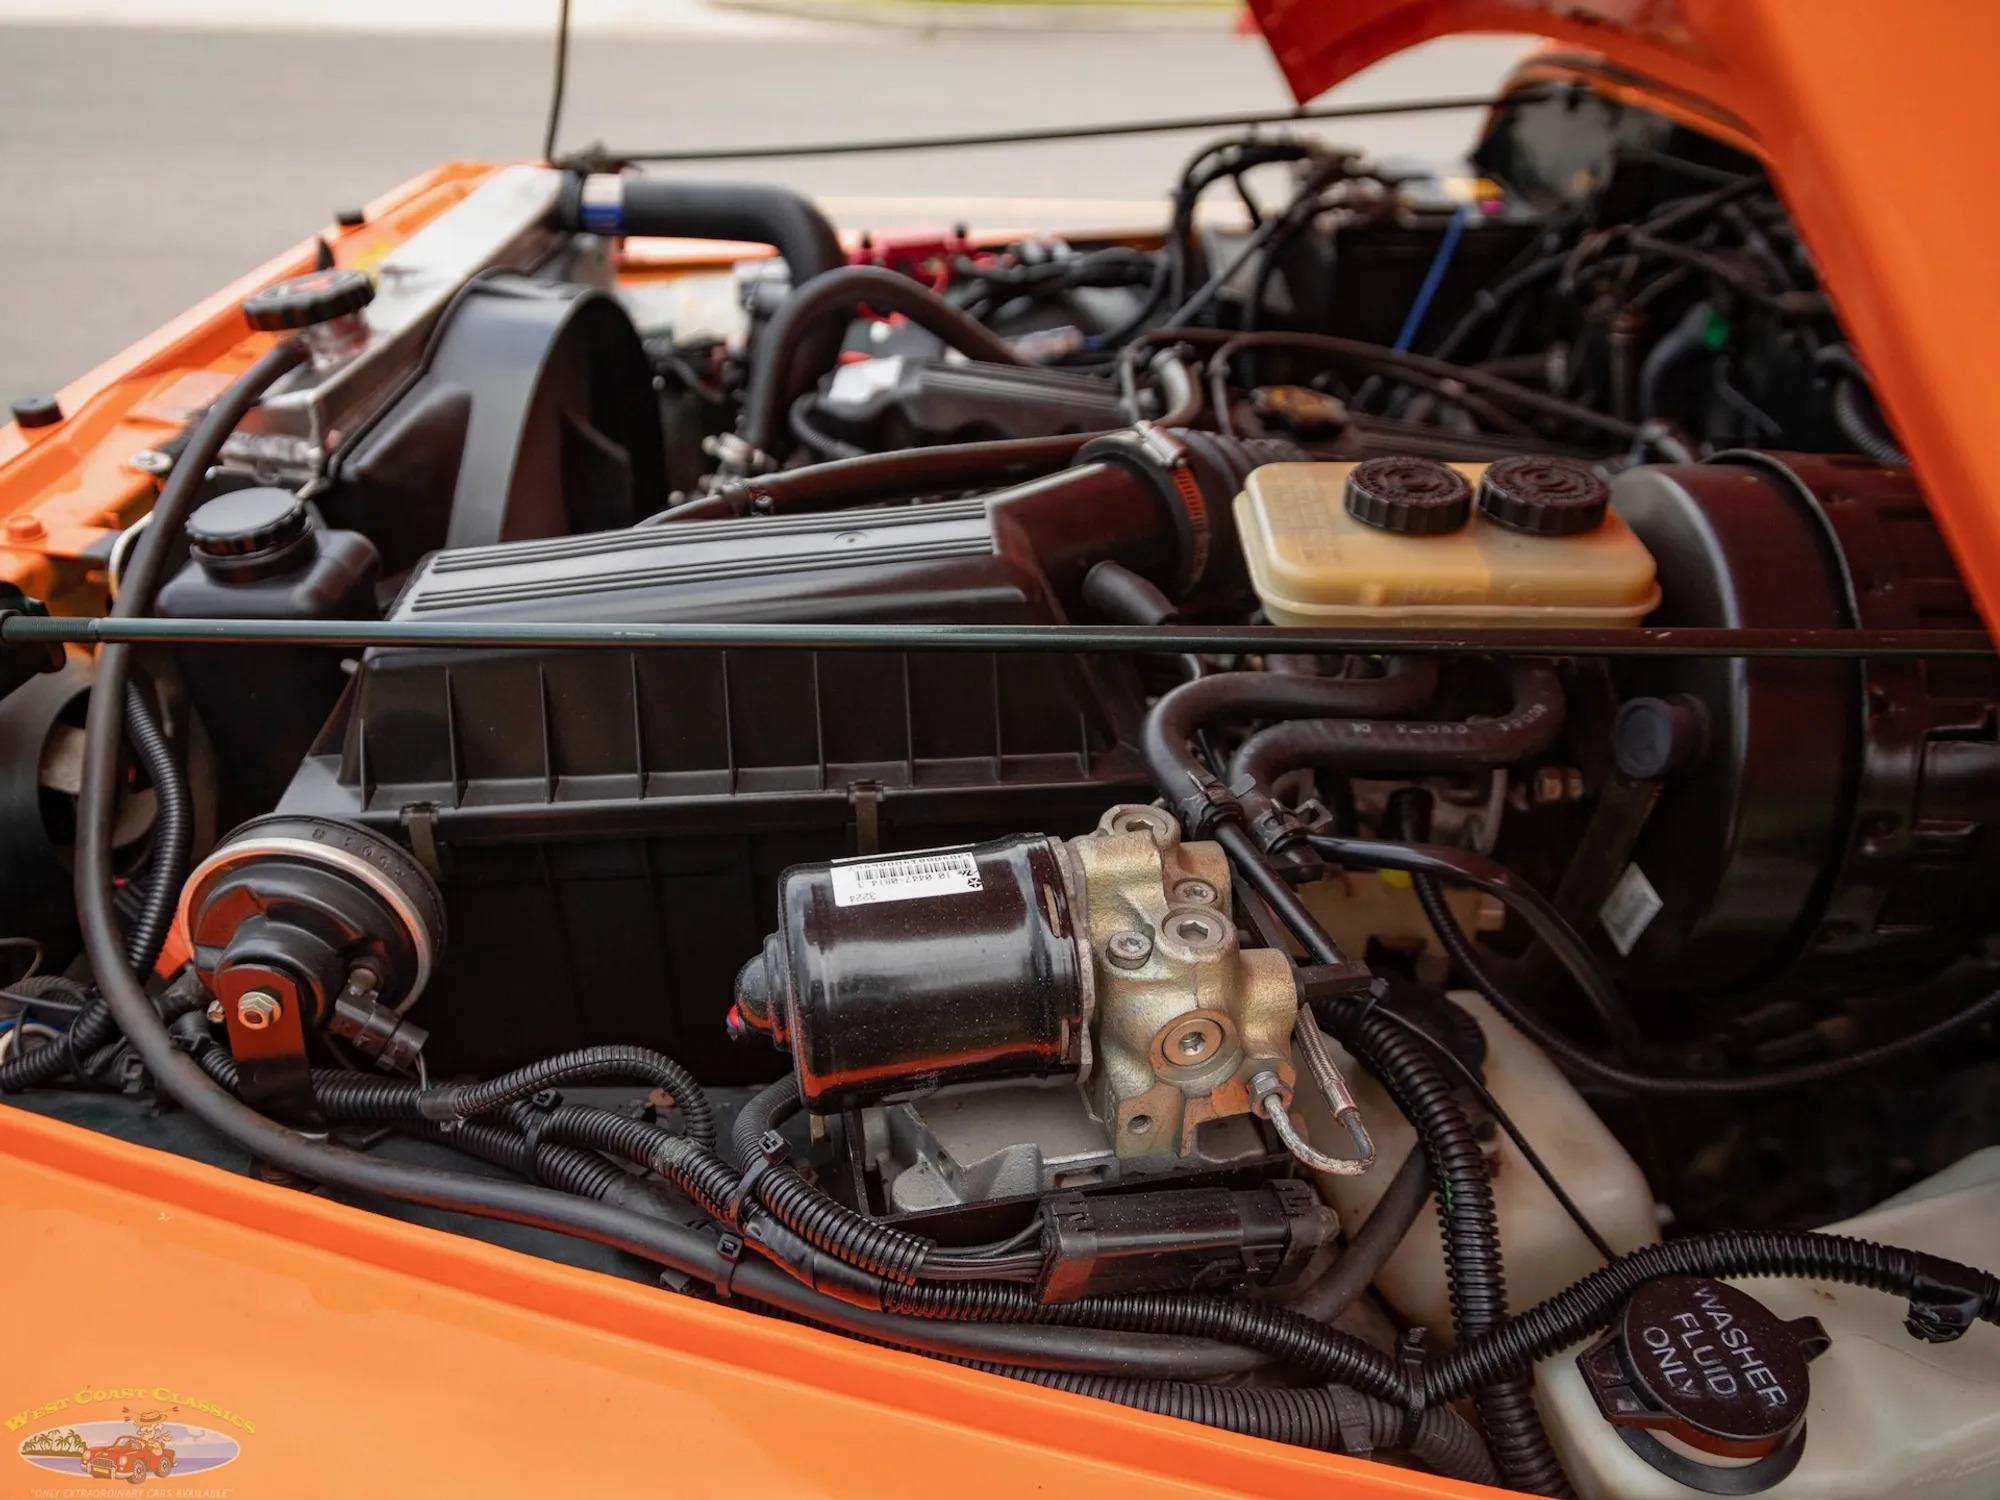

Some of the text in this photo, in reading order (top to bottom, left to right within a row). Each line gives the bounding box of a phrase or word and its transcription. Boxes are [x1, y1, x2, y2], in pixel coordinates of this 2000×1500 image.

[1643, 1326, 1697, 1394] ONLY
[1671, 1312, 1738, 1395] FLUID
[1694, 1287, 1787, 1407] WASHER
